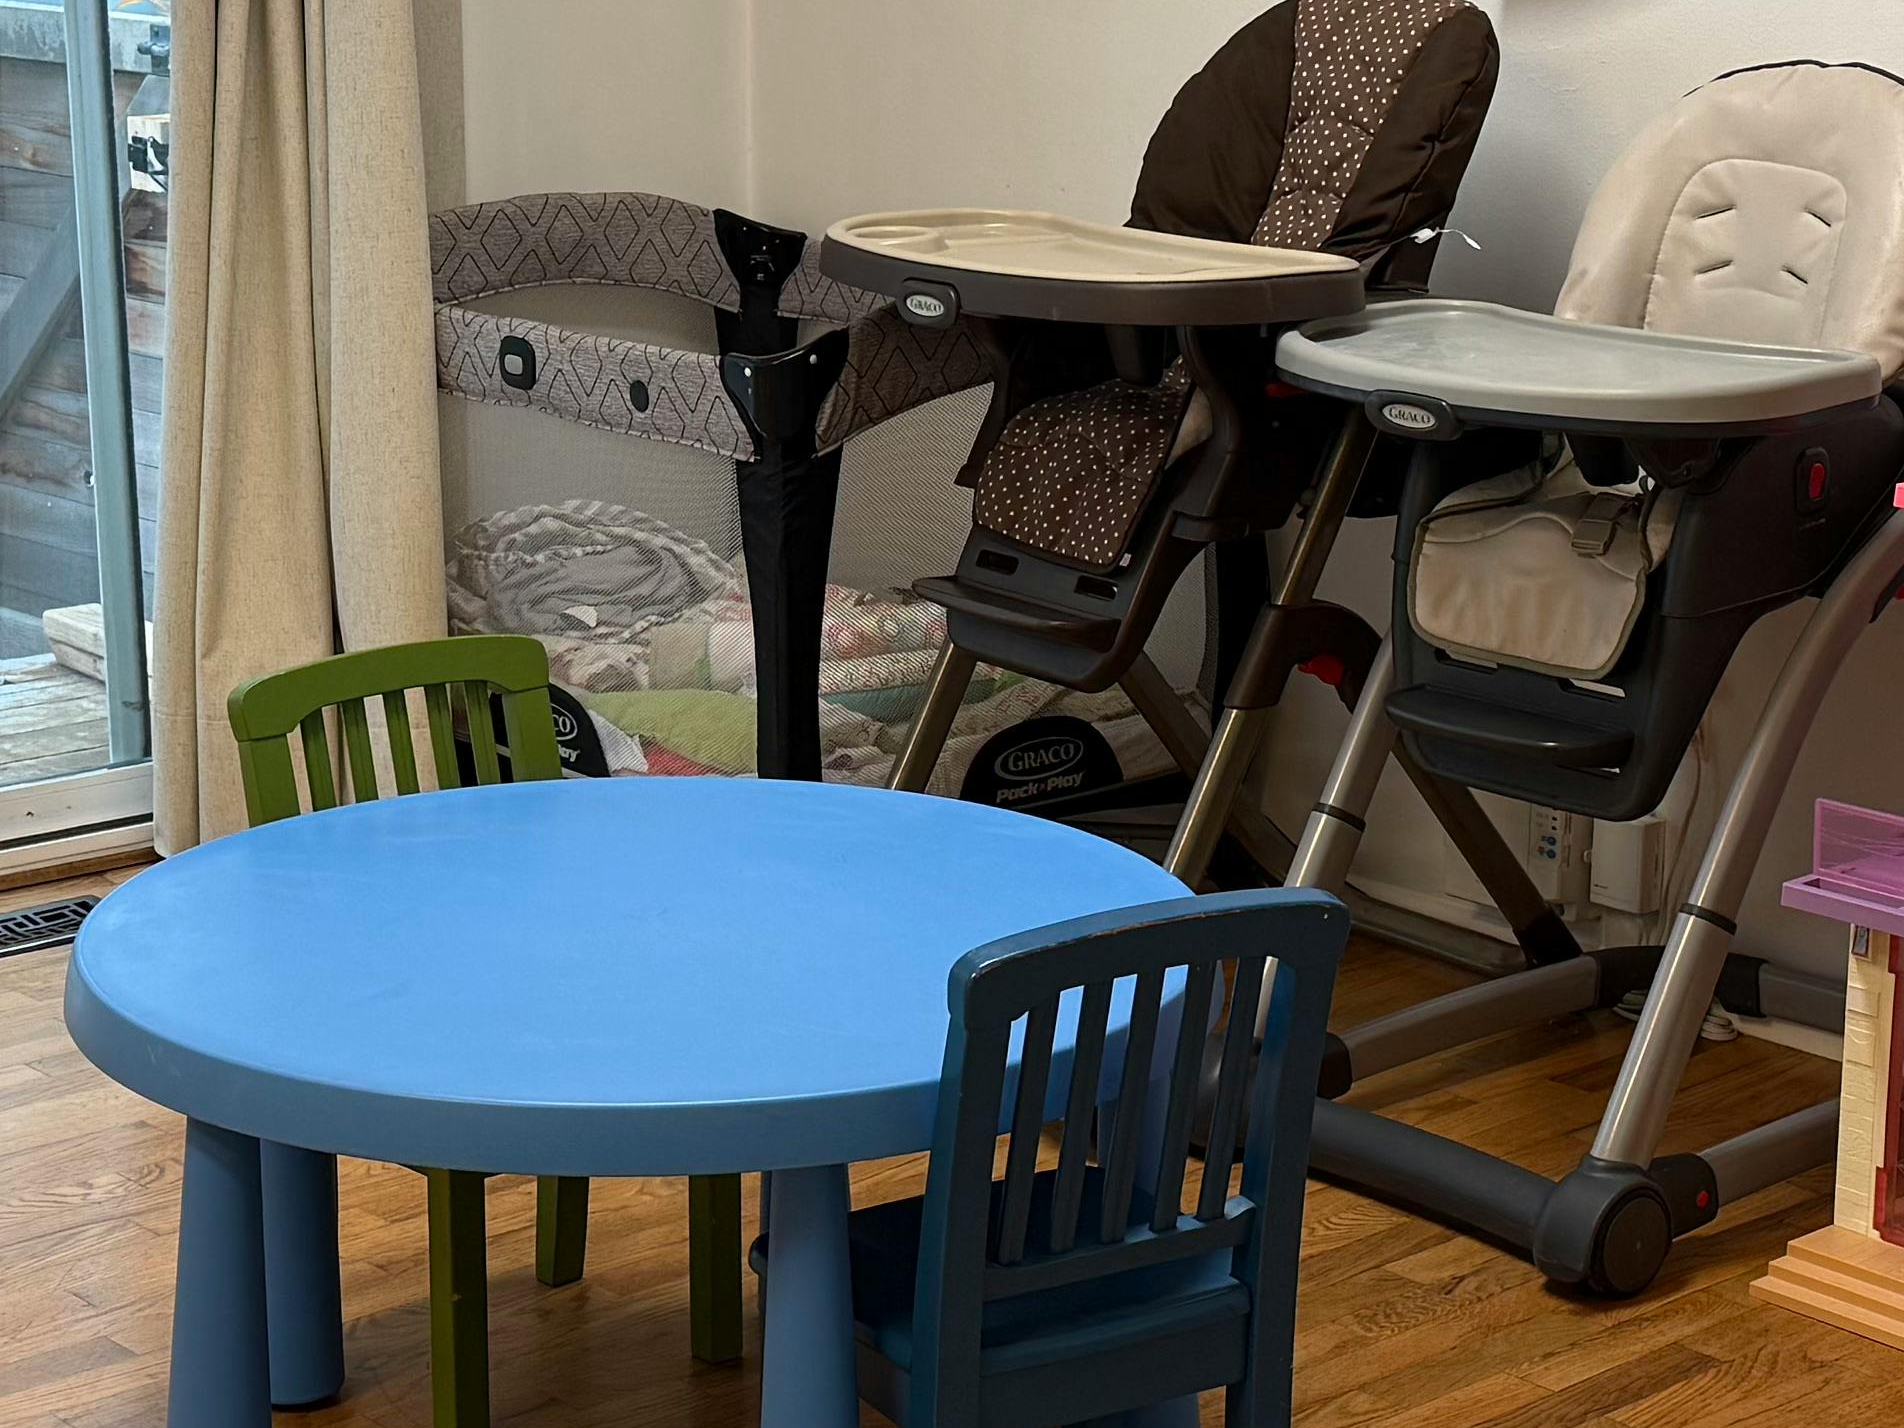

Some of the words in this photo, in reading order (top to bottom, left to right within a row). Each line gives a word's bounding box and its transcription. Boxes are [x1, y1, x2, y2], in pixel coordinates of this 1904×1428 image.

[1389, 407, 1431, 424] GRACO
[1007, 742, 1075, 772] GRACO
[996, 781, 1039, 804] Pack
[1047, 770, 1086, 792] Play
